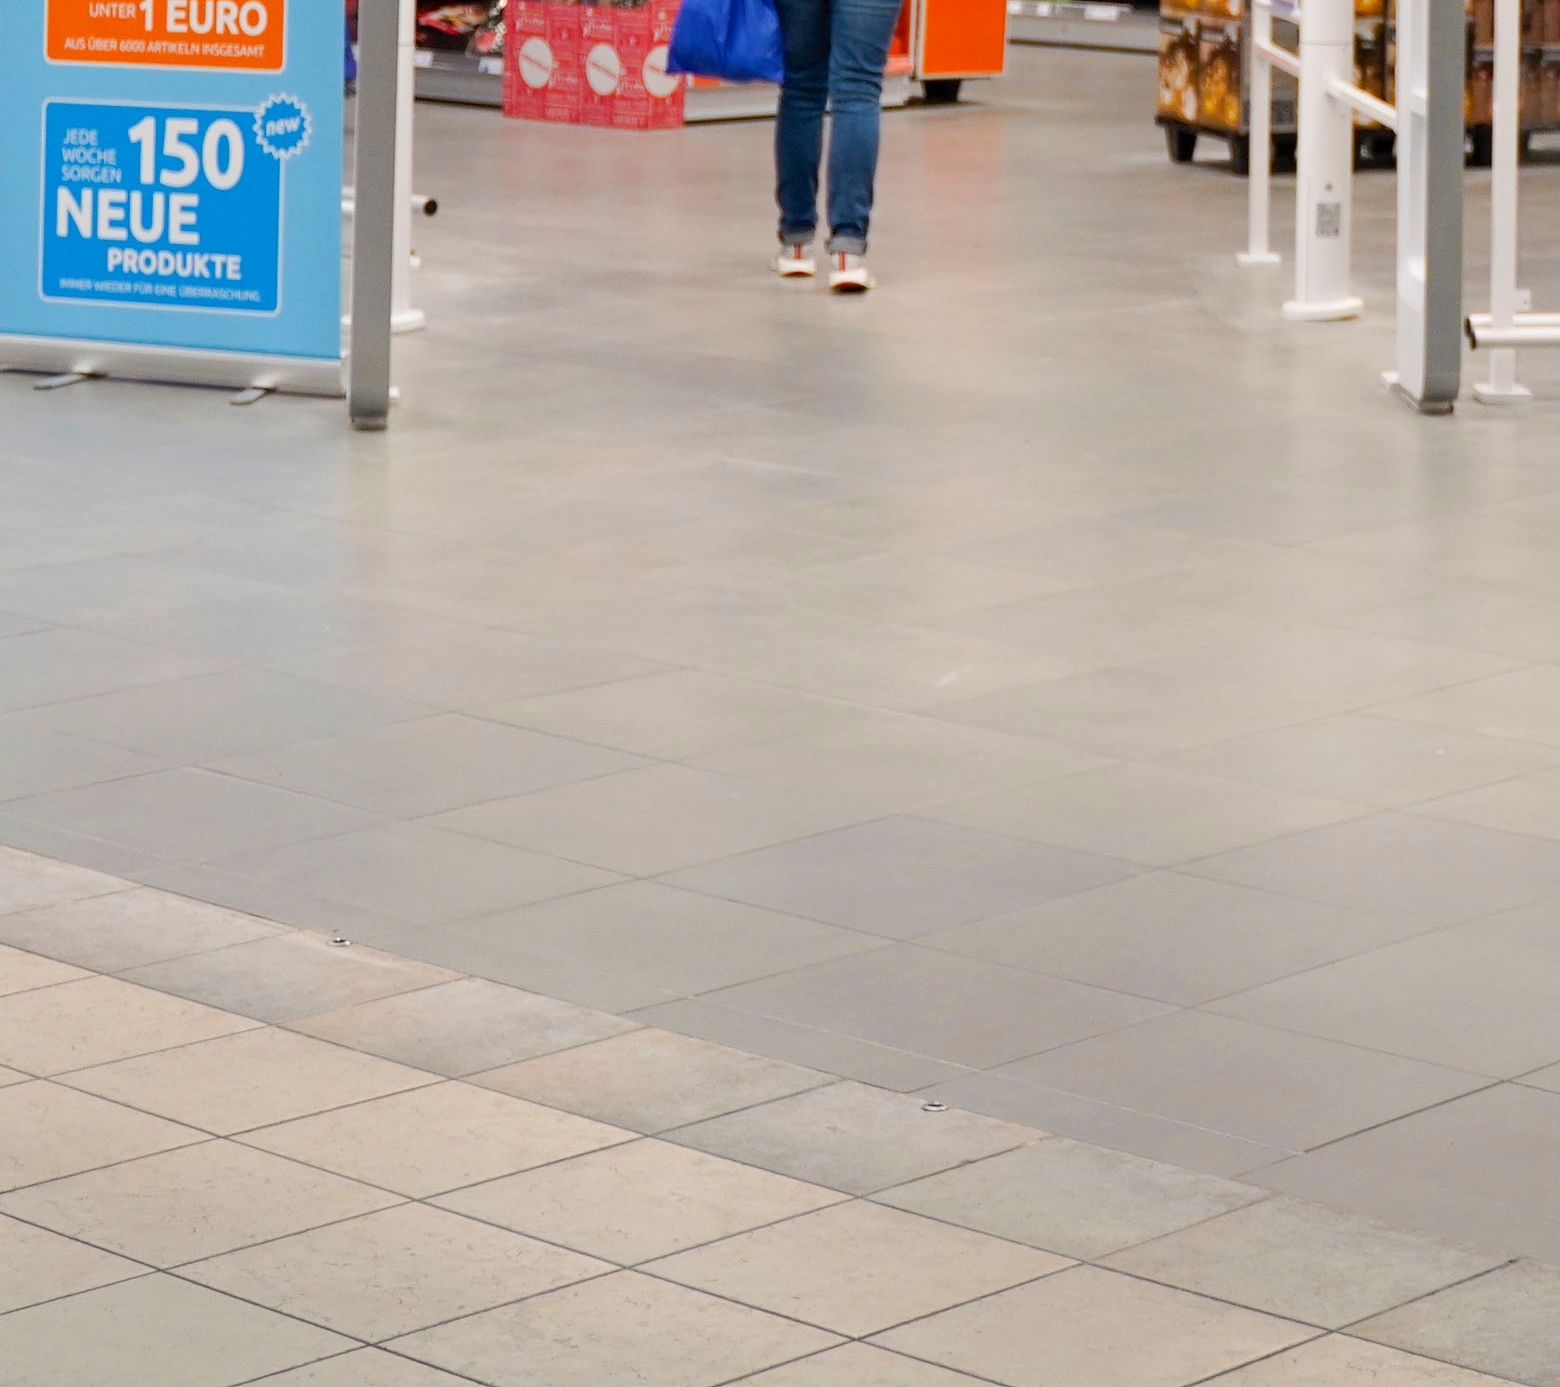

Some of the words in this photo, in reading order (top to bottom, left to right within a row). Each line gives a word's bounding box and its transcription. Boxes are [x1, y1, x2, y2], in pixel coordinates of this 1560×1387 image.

[89, 2, 136, 20] UNTER
[64, 37, 87, 51] AUS
[88, 37, 118, 52] ÜBER
[119, 39, 145, 53] 6000
[147, 40, 200, 56] ARTIKELN
[202, 43, 265, 58] INSGESAMT
[61, 147, 117, 165] WOCHE
[64, 128, 98, 147] JEDE
[128, 116, 245, 190] 150
[265, 115, 301, 138] new
[61, 166, 122, 183] SORGEN
[56, 185, 200, 245] NEUE
[107, 247, 243, 280] PRODUKTE
